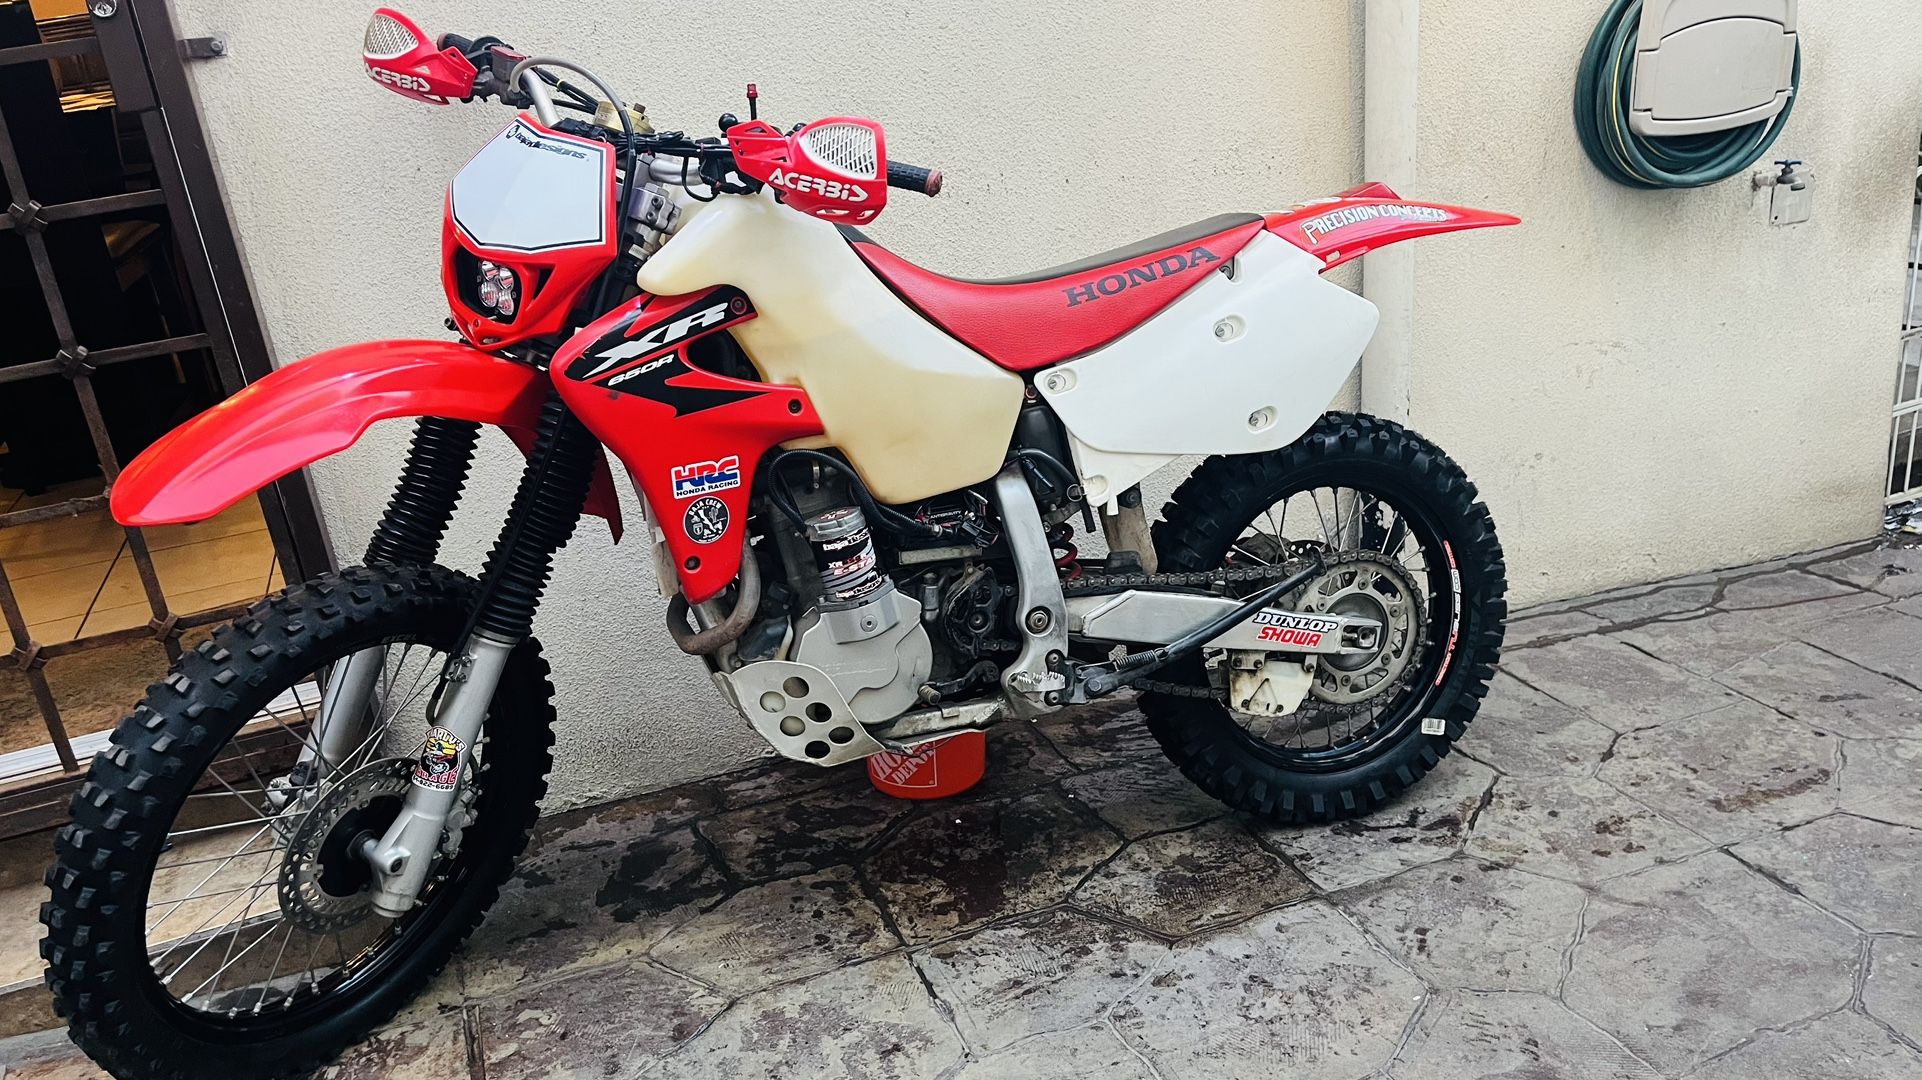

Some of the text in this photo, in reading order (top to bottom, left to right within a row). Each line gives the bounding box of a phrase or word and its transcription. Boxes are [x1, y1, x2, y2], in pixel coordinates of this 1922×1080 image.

[768, 168, 869, 202] ACERBIS
[1301, 203, 1447, 245] PRECISION CONCEPTS
[1062, 245, 1221, 308] HONDA
[582, 302, 729, 379] XR
[608, 353, 675, 387] 650R
[674, 457, 739, 491] HRC
[676, 479, 739, 497] HONDA RACING
[705, 498, 722, 509] CREW
[1253, 611, 1338, 634] DUNLOP
[1257, 627, 1323, 648] SHOWA
